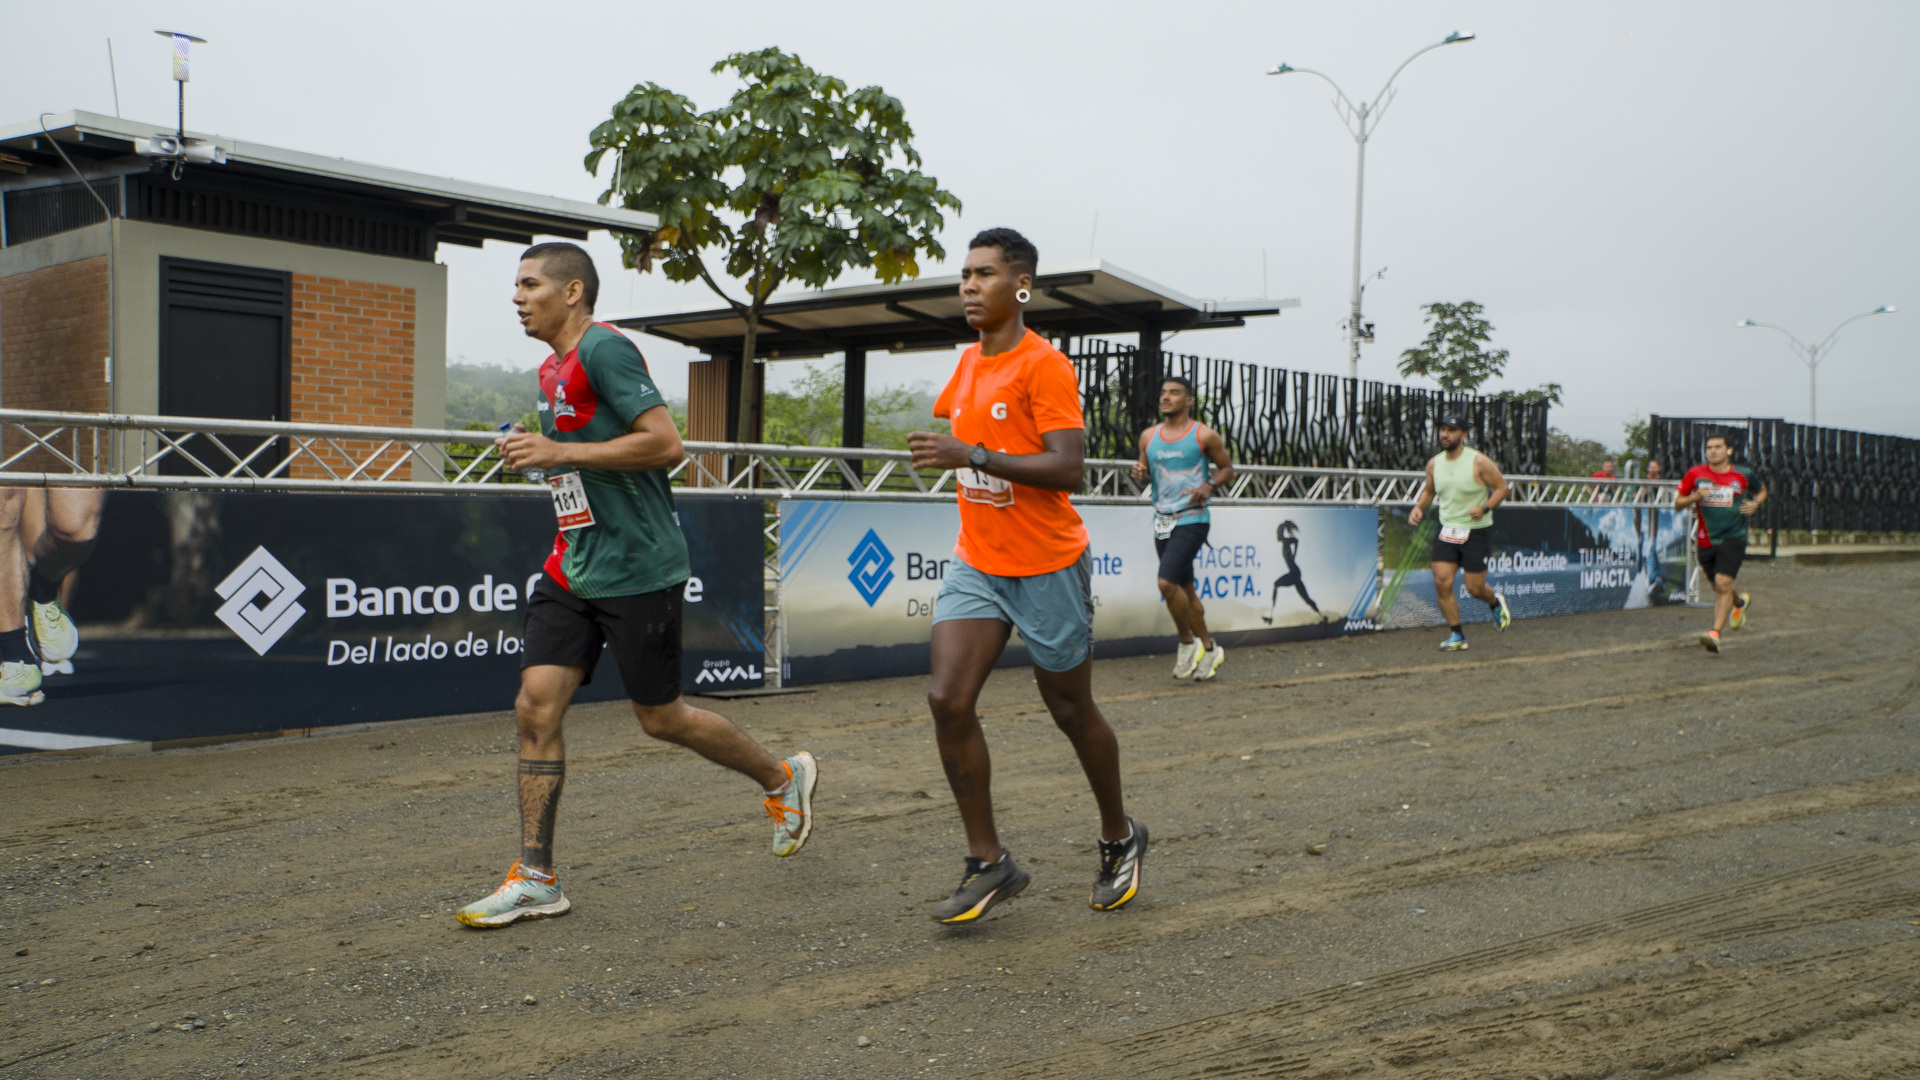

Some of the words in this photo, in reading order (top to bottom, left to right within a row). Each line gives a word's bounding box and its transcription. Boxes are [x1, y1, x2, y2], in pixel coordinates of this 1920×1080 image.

[991, 402, 1007, 420] G
[554, 491, 578, 513] 181
[1498, 551, 1512, 573] de
[1513, 551, 1567, 573] Occidente
[1579, 547, 1594, 567] TU
[326, 577, 460, 618] Banco
[468, 573, 518, 612] de
[1505, 580, 1516, 596] los
[1516, 582, 1531, 597] que
[907, 597, 935, 617] Del
[1344, 618, 1374, 631] AVAL
[326, 636, 377, 666] Del
[384, 633, 448, 662] lado
[454, 631, 489, 658] de
[703, 659, 731, 669] Grupo
[695, 664, 762, 685] AVAL
